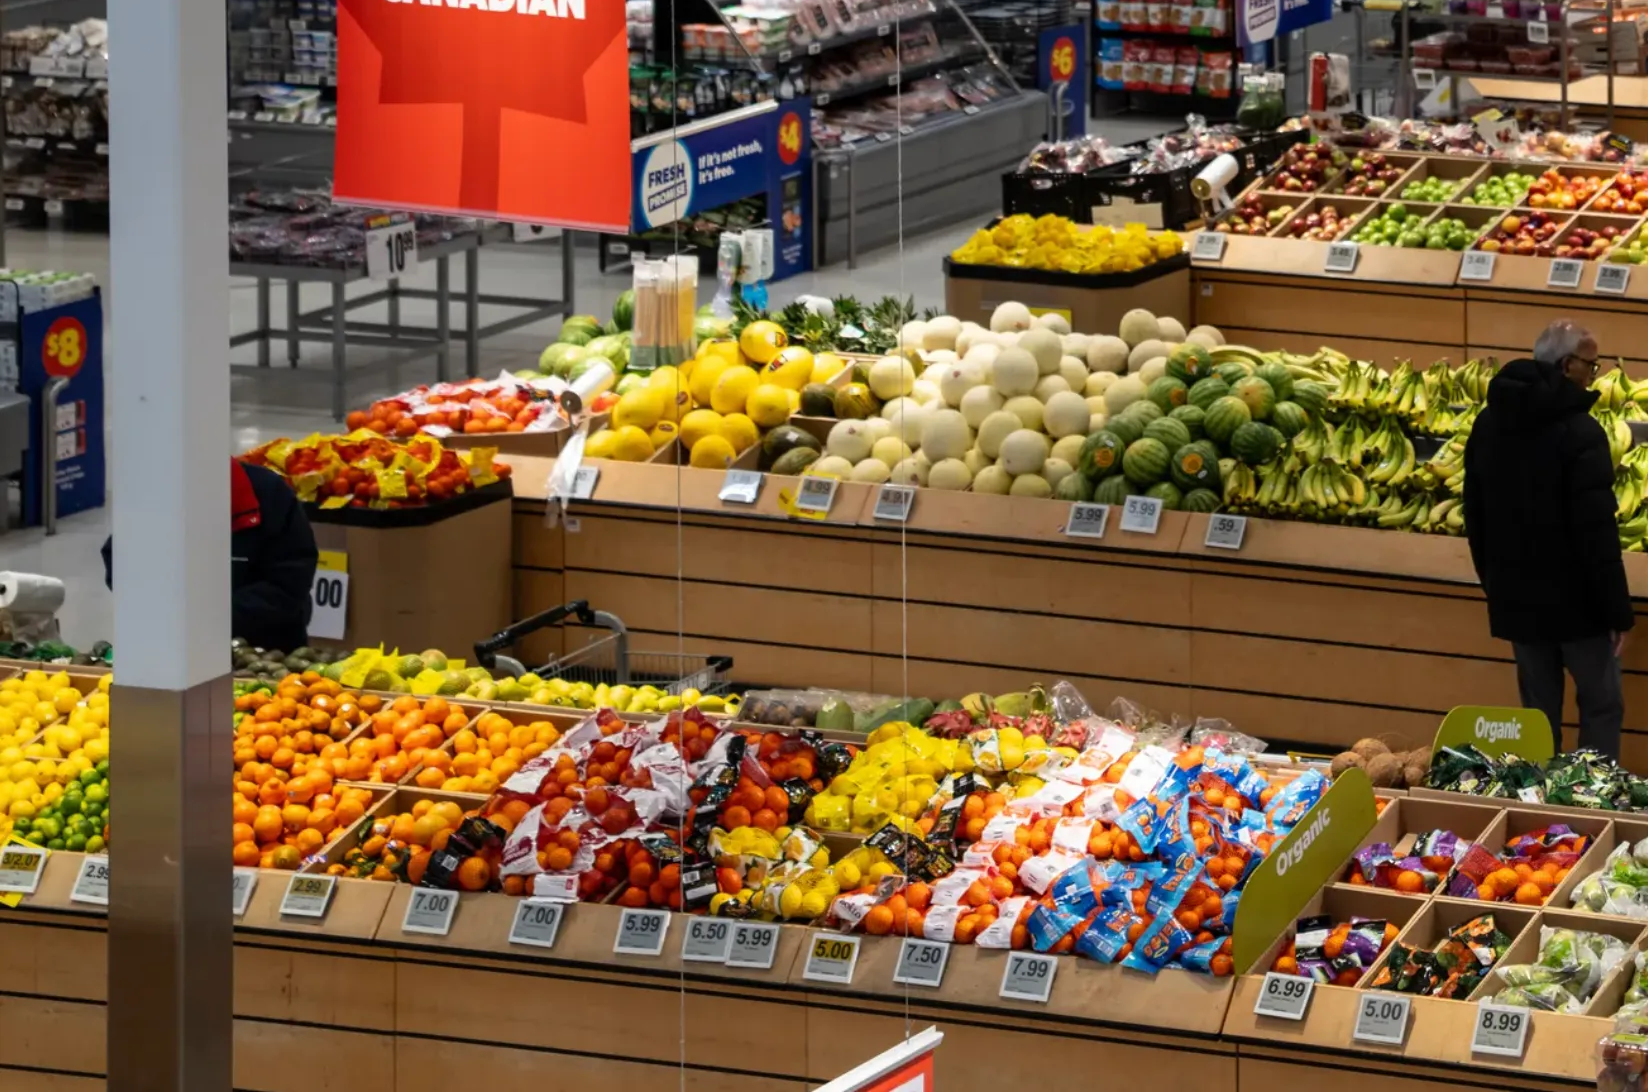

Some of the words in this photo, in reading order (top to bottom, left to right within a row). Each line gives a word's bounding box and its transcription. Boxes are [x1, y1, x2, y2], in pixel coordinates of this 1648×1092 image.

[648, 162, 686, 189] FRESH
[47, 328, 80, 367] $8
[1075, 507, 1102, 521] 5.99
[1129, 501, 1156, 516] 5.99
[1475, 716, 1522, 743] Organic
[1275, 804, 1331, 877] Organic
[295, 879, 322, 893] 2.99
[415, 893, 450, 912] 7.00
[521, 905, 556, 925] 7.00
[625, 915, 661, 932] 5.99
[692, 922, 727, 940] 6.50
[736, 928, 772, 946] 5.99
[815, 940, 851, 960] 5.00
[906, 944, 942, 964] 7.50
[1012, 958, 1048, 978] 7.99
[1268, 978, 1306, 998] 6.99
[1364, 1000, 1403, 1021] 5.00
[1482, 1011, 1521, 1032] 8.99
